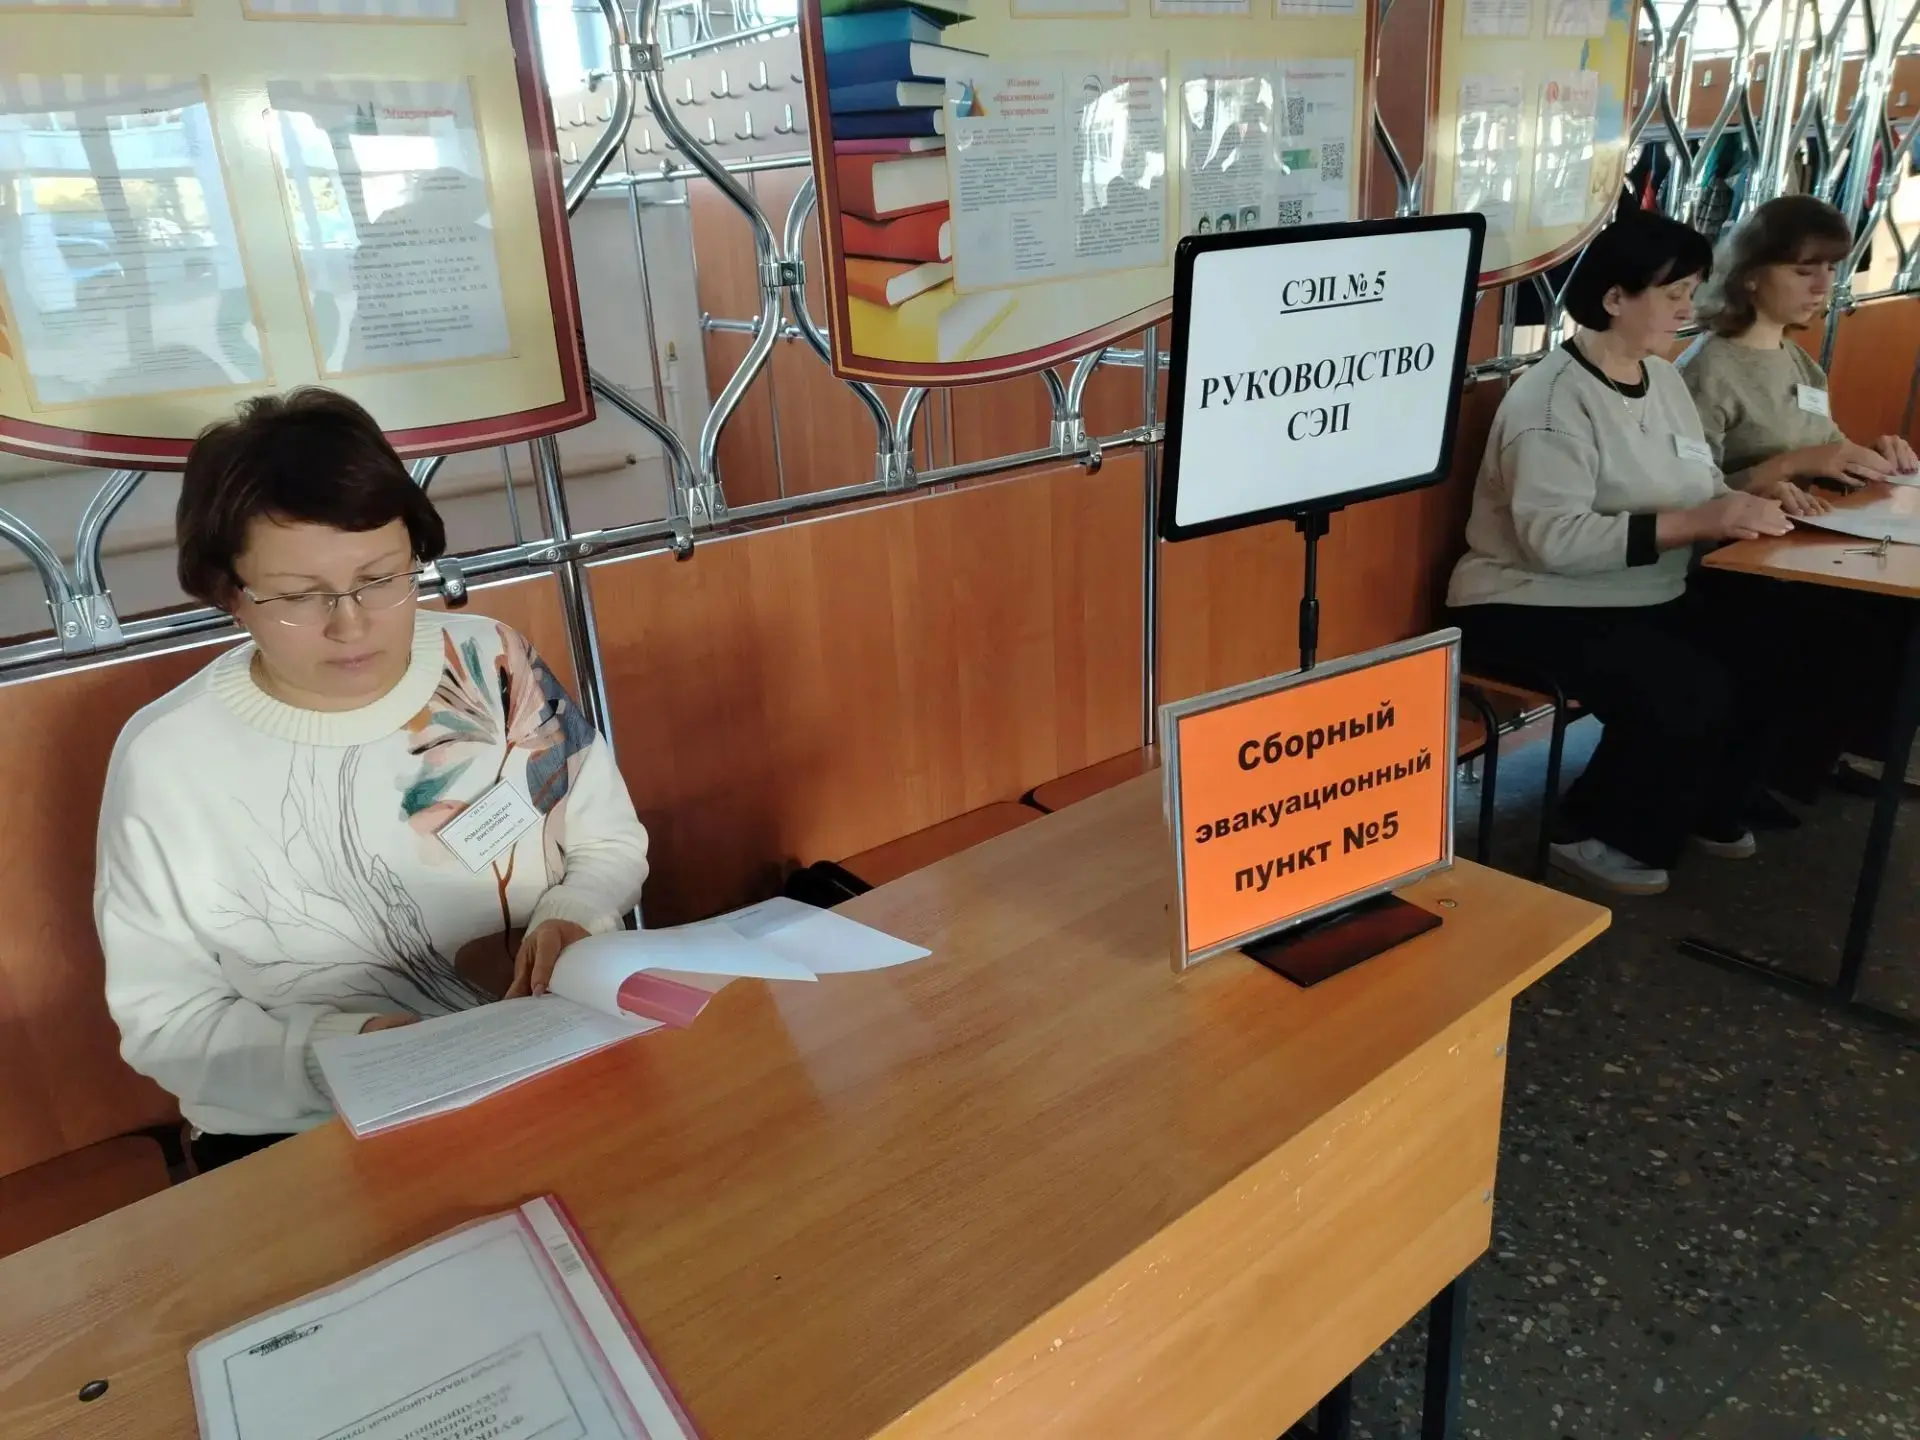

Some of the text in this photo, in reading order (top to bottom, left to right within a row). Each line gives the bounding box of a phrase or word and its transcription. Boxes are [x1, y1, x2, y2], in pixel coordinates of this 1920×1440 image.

[1282, 270, 1387, 307] СЭП № 5
[1199, 342, 1435, 409] РУКОВОДСТВО
[1287, 402, 1351, 441] СЭП
[1238, 699, 1395, 771] Сборный
[1195, 747, 1432, 844] эвакуационный
[1235, 810, 1399, 892] пункт №5
